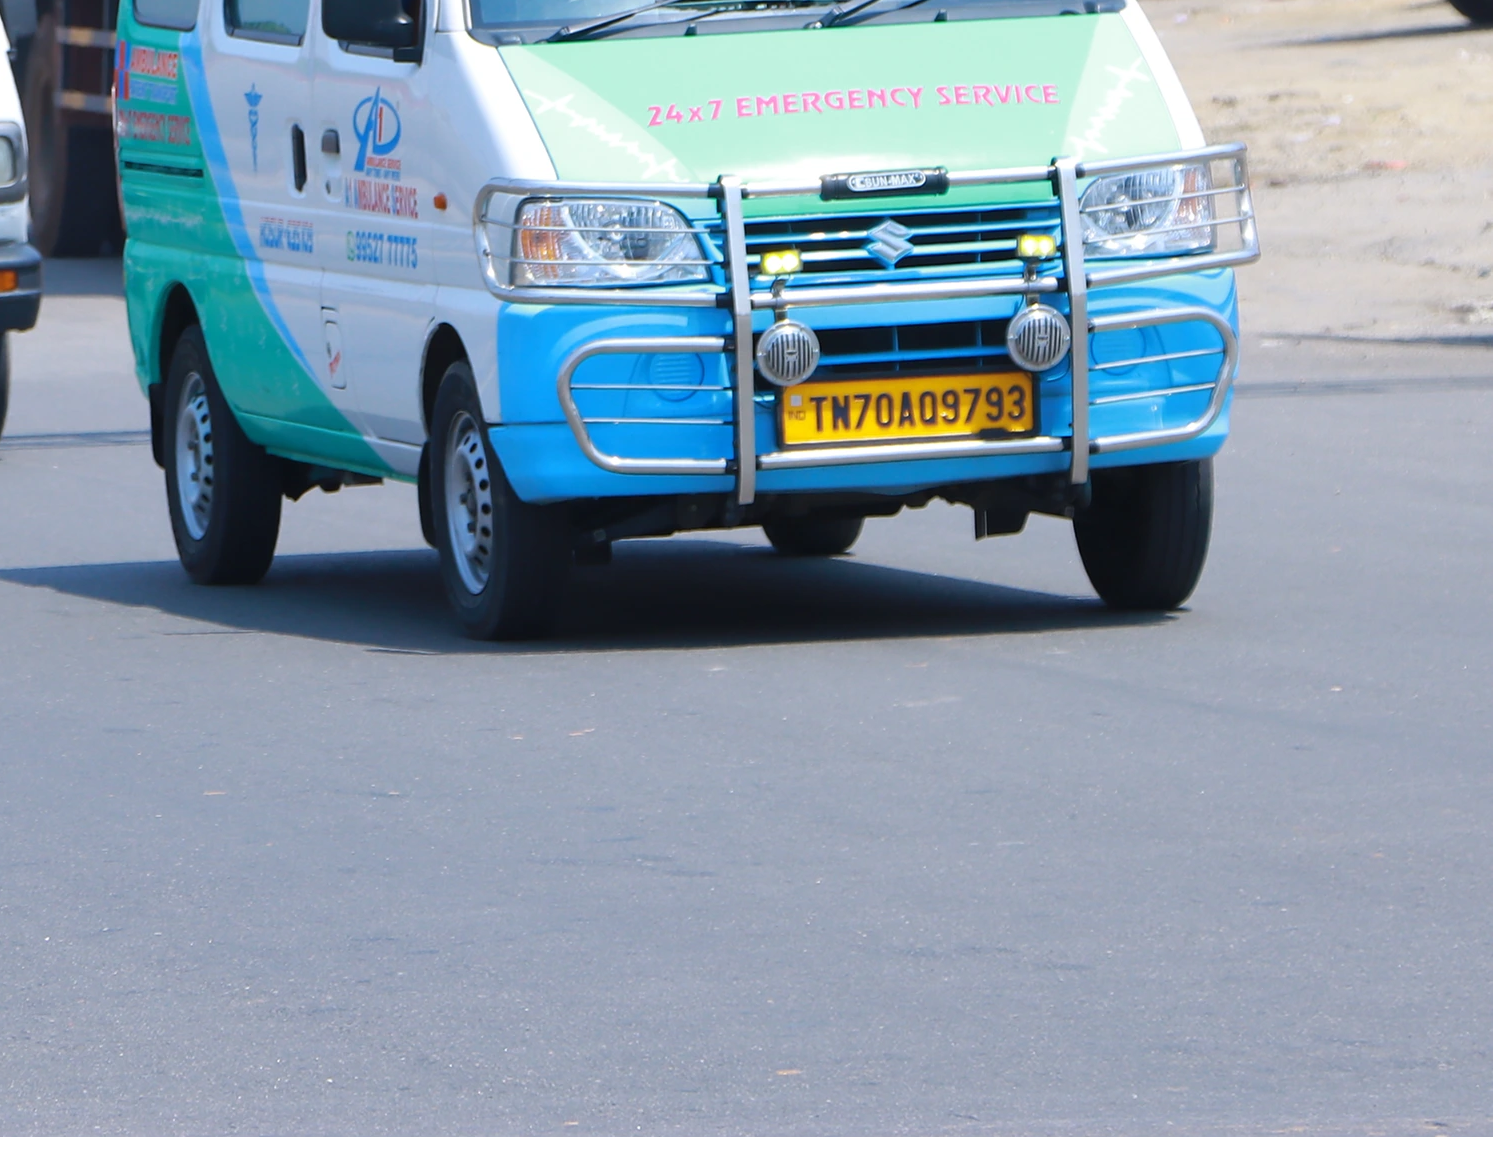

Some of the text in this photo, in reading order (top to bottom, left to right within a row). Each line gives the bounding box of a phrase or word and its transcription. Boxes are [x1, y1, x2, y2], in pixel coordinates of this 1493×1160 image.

[131, 46, 178, 79] AMBULANCE
[647, 84, 1062, 127] 24x7 EMERGENCY SERVICE
[809, 385, 1026, 432] TN70AQ9793
